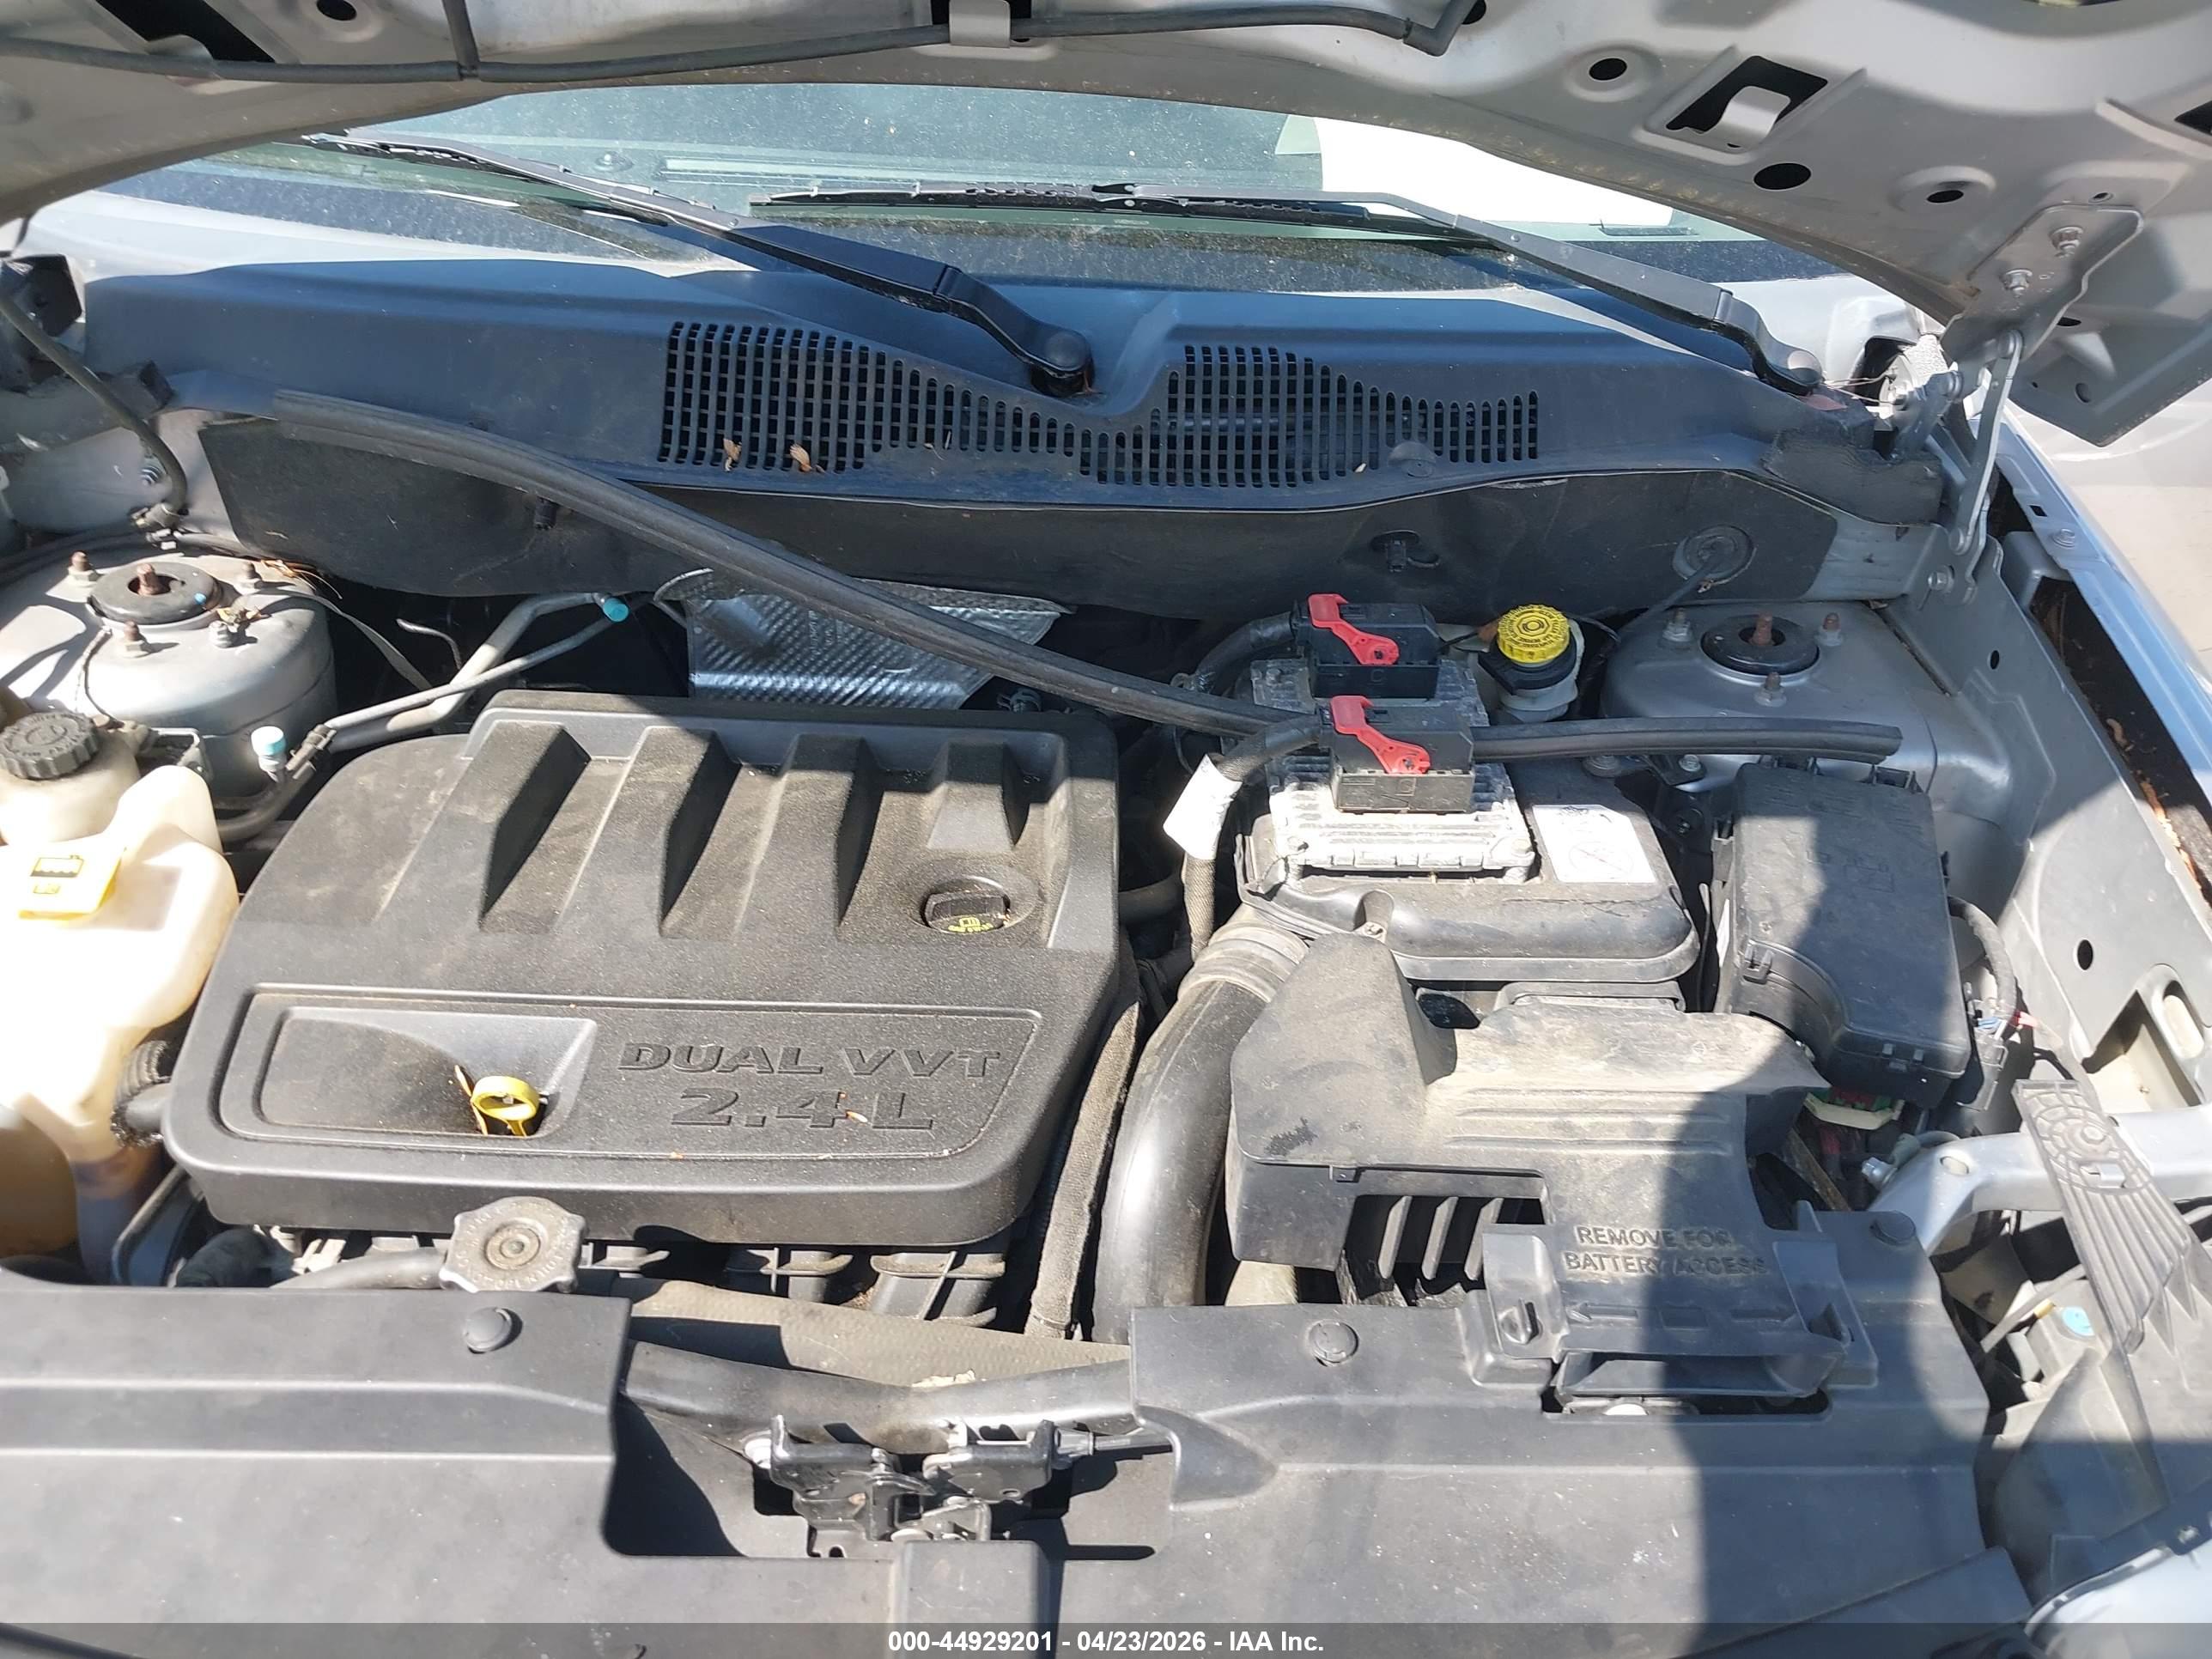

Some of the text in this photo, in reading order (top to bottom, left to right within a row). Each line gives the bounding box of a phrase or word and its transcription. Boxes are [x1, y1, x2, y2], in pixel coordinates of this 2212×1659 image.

[617, 1042, 1000, 1078] DUAL VVT
[671, 1087, 934, 1130] 2.4L
[1575, 1225, 1733, 1249] REMOVE FOR
[1562, 1250, 1770, 1276] BATTERY ACCESS
